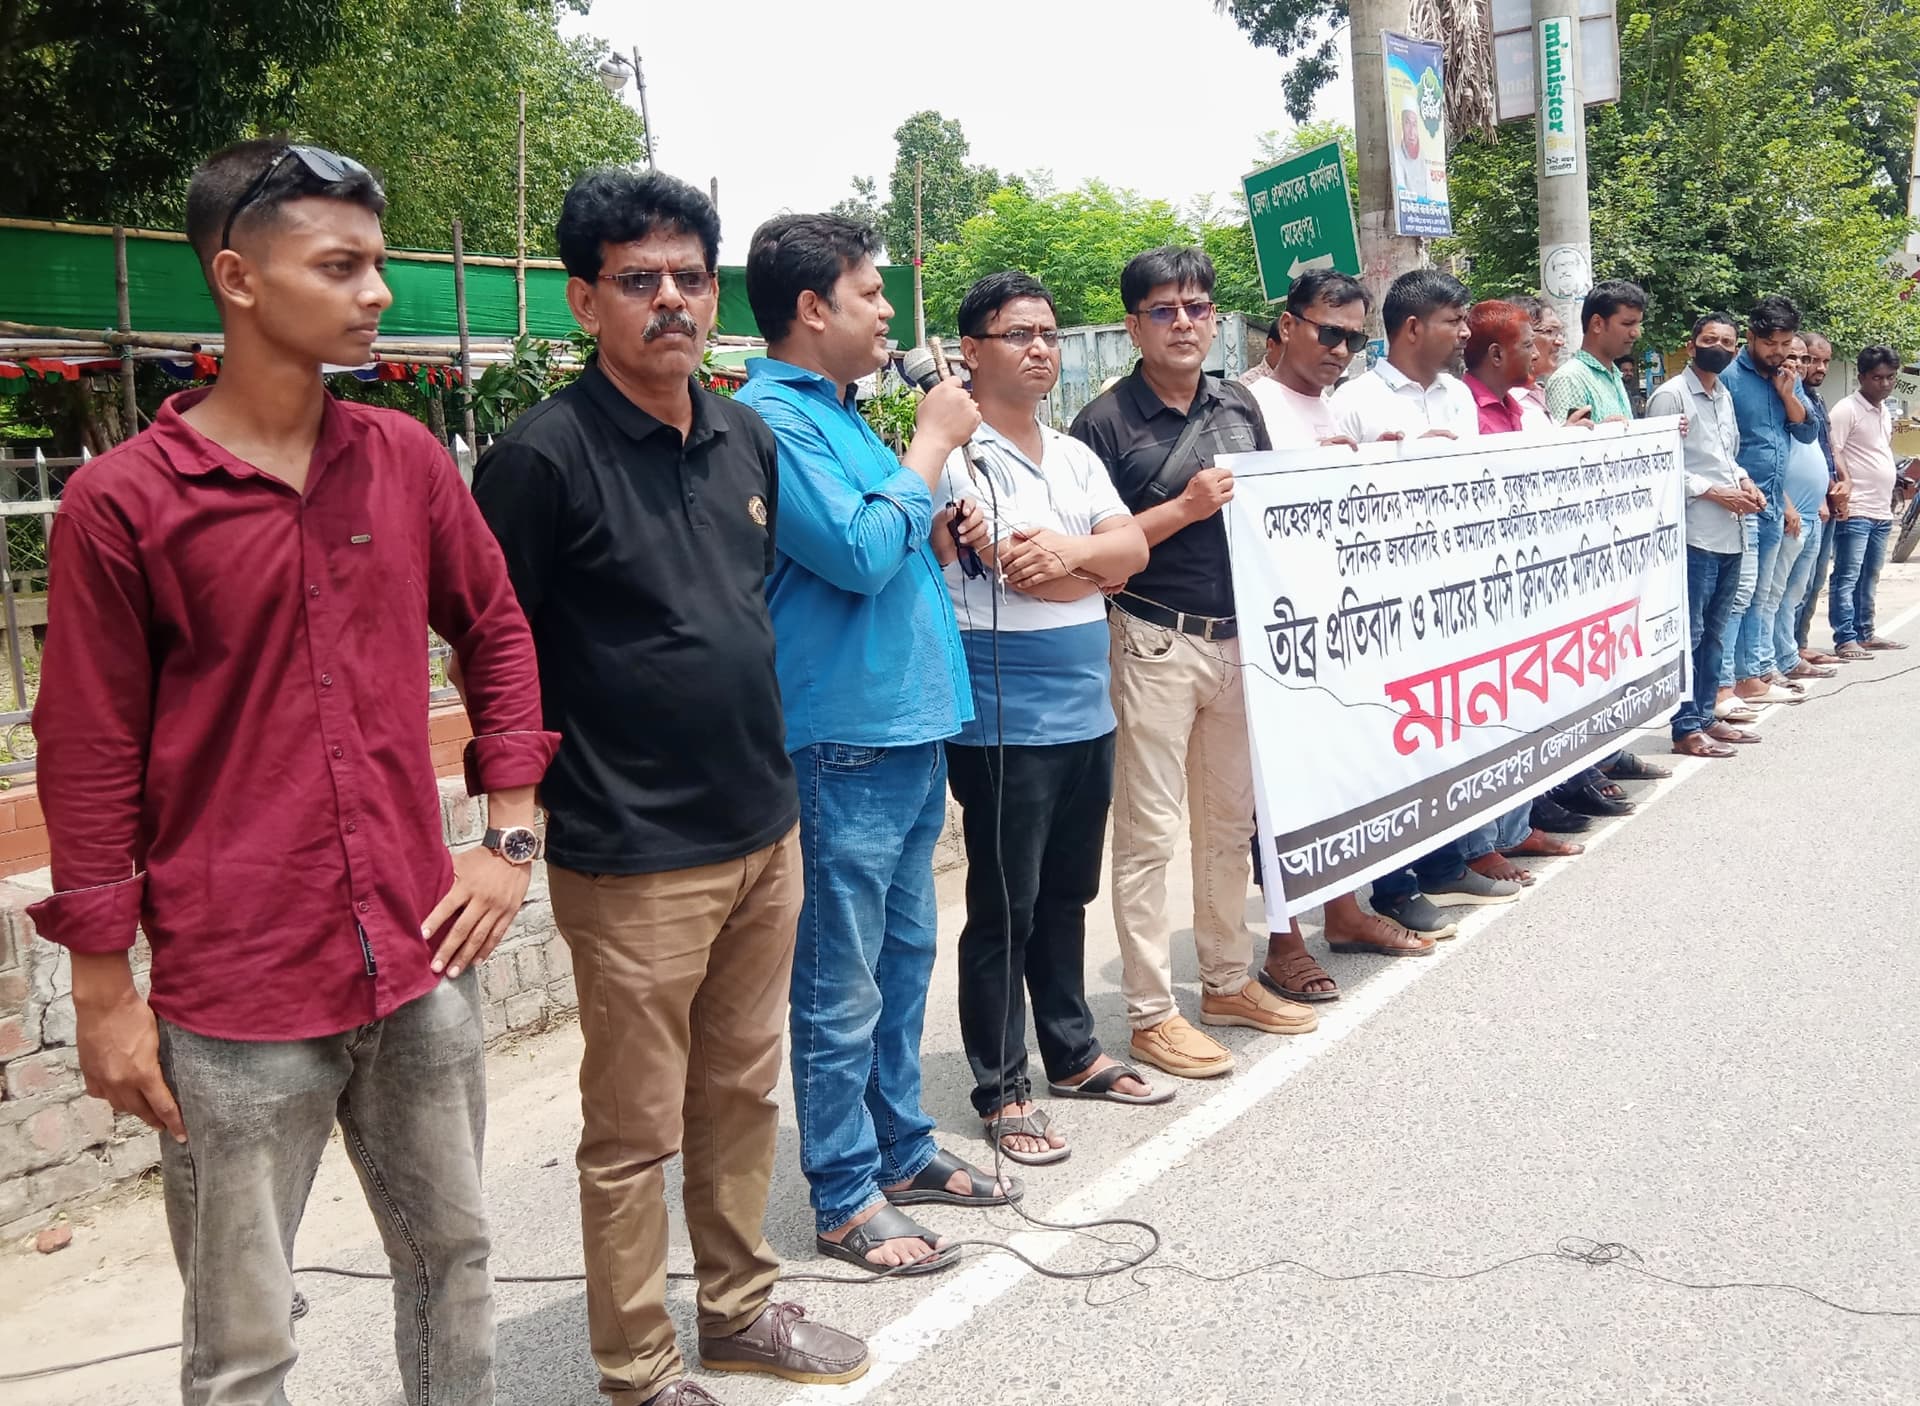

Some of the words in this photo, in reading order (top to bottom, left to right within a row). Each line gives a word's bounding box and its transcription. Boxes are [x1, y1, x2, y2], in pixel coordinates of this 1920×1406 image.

[1545, 22, 1568, 132] minister
[1251, 187, 1271, 218] জেলা
[1271, 175, 1309, 209] প্রশাসকের
[1264, 497, 1333, 542] মেহেরপুর
[1337, 482, 1402, 529] প্রতিদিনের
[1541, 465, 1580, 496] সম্পাদকের
[1335, 531, 1381, 576] দৈনিক
[1384, 520, 1440, 567] জবাবদিহি
[1442, 529, 1451, 553] ও
[1453, 520, 1496, 552] আমাদের
[1497, 504, 1538, 543] অর্থনীতির
[1264, 596, 1318, 684] তীব্র
[1326, 586, 1402, 669] প্রতিবাদ
[1409, 595, 1425, 640] ও
[1429, 579, 1478, 638] মায়ের
[1480, 553, 1514, 626] হাসি
[1515, 545, 1569, 618] ক্লিনিকের
[1569, 533, 1615, 595] মালিকের
[1384, 595, 1643, 756] মানববন্ধন
[1278, 798, 1422, 877] আয়োজনে
[1446, 746, 1535, 811] মেহেরপুর
[1540, 718, 1589, 765] জেলার
[1591, 684, 1653, 734] সাংবাদিক
